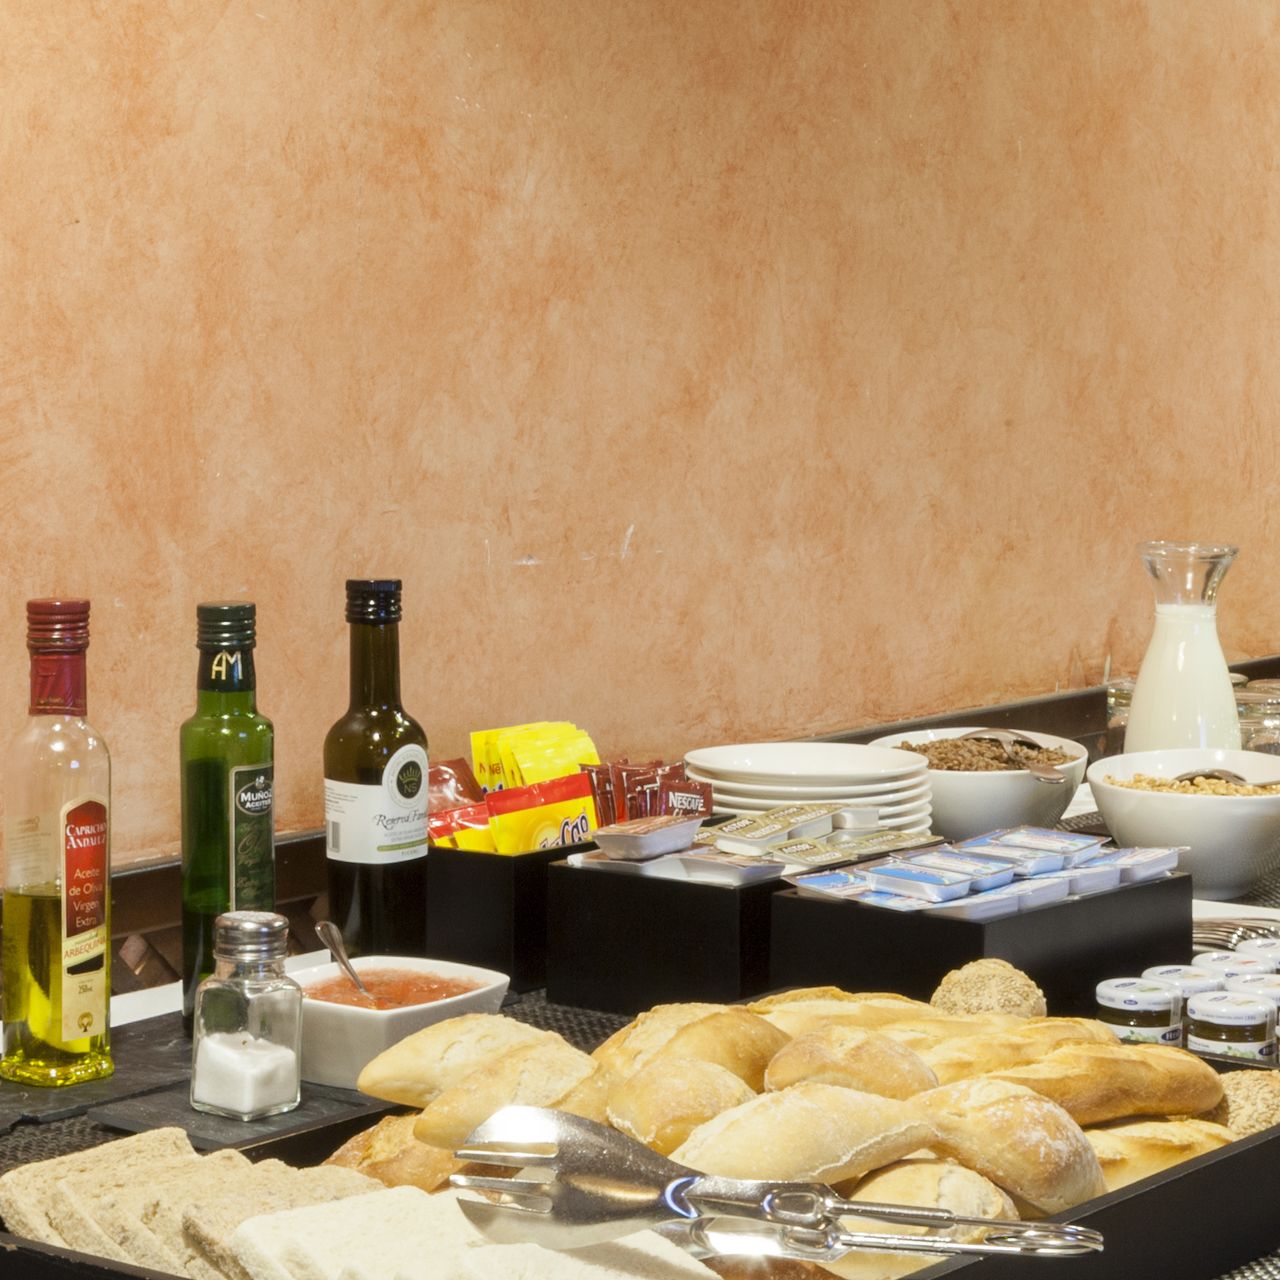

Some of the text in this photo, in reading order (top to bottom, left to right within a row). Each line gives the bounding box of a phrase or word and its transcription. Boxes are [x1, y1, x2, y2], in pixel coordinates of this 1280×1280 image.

[73, 868, 100, 879] Aceite
[68, 886, 81, 896] de
[72, 900, 100, 913] Virgen
[76, 917, 97, 928] Extra
